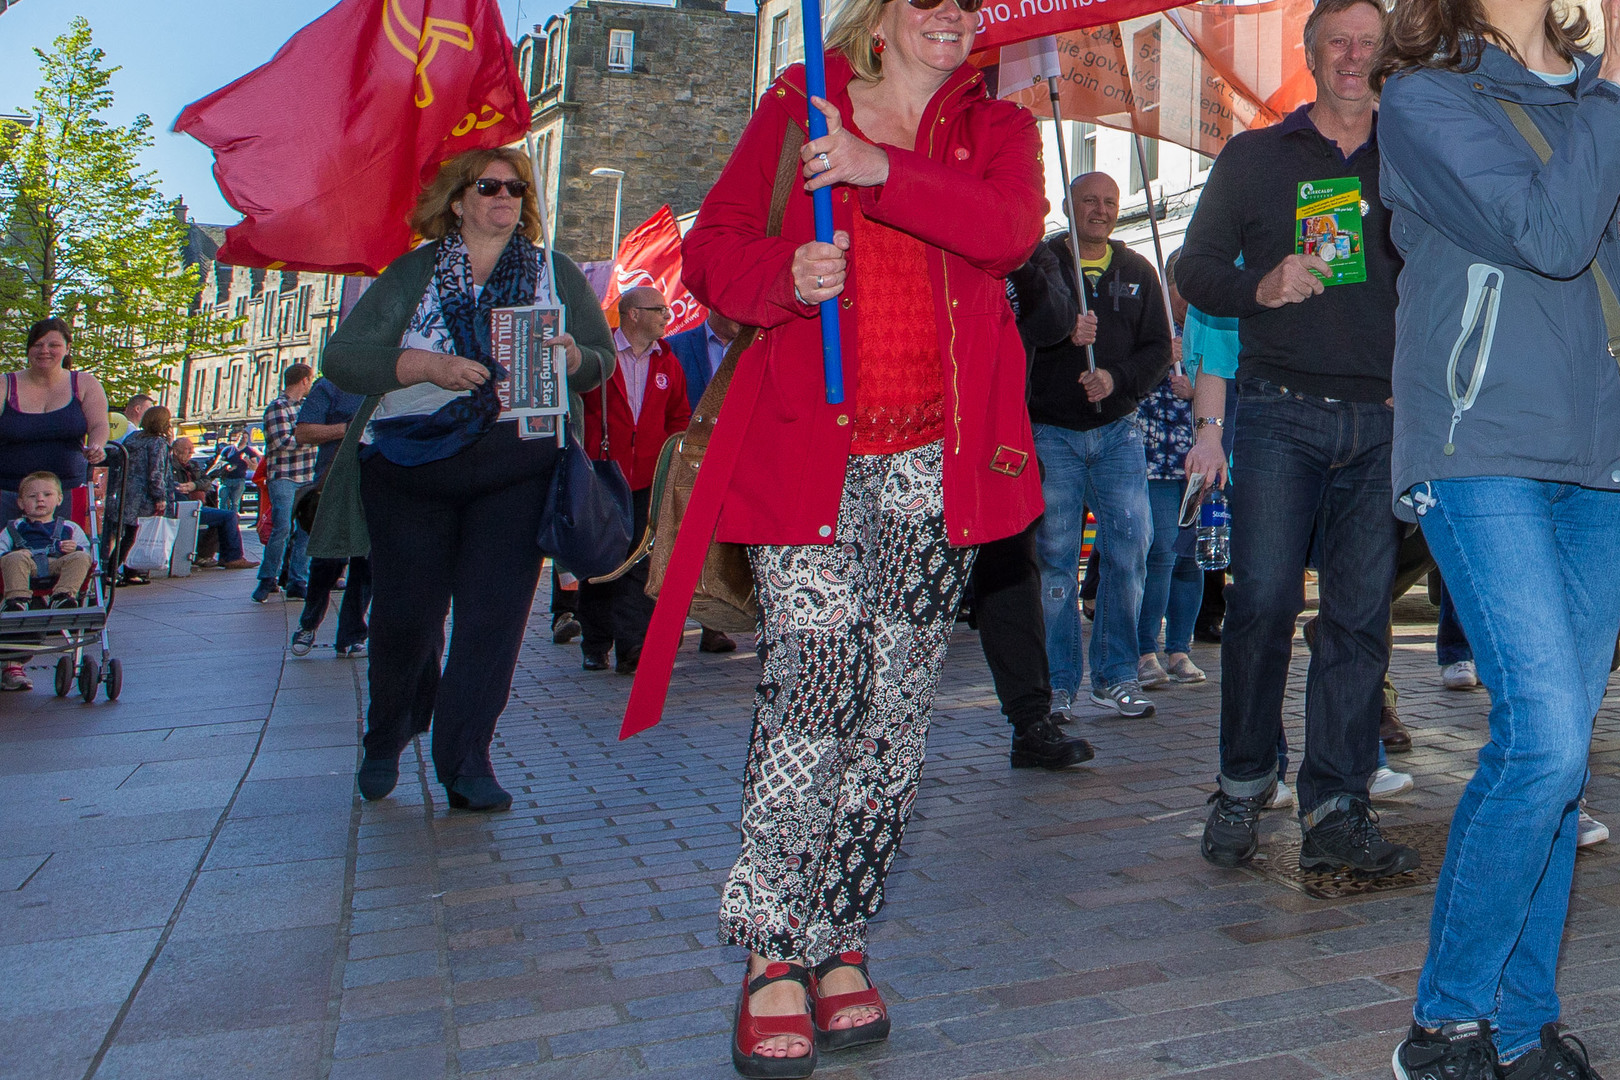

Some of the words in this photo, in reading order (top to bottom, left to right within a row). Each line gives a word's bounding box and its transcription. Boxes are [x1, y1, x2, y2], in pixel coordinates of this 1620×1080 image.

[1061, 68, 1099, 92] Join
[499, 313, 512, 342] STILL
[498, 344, 511, 362] ALL
[540, 327, 554, 380] Mrning
[542, 381, 554, 407] Star
